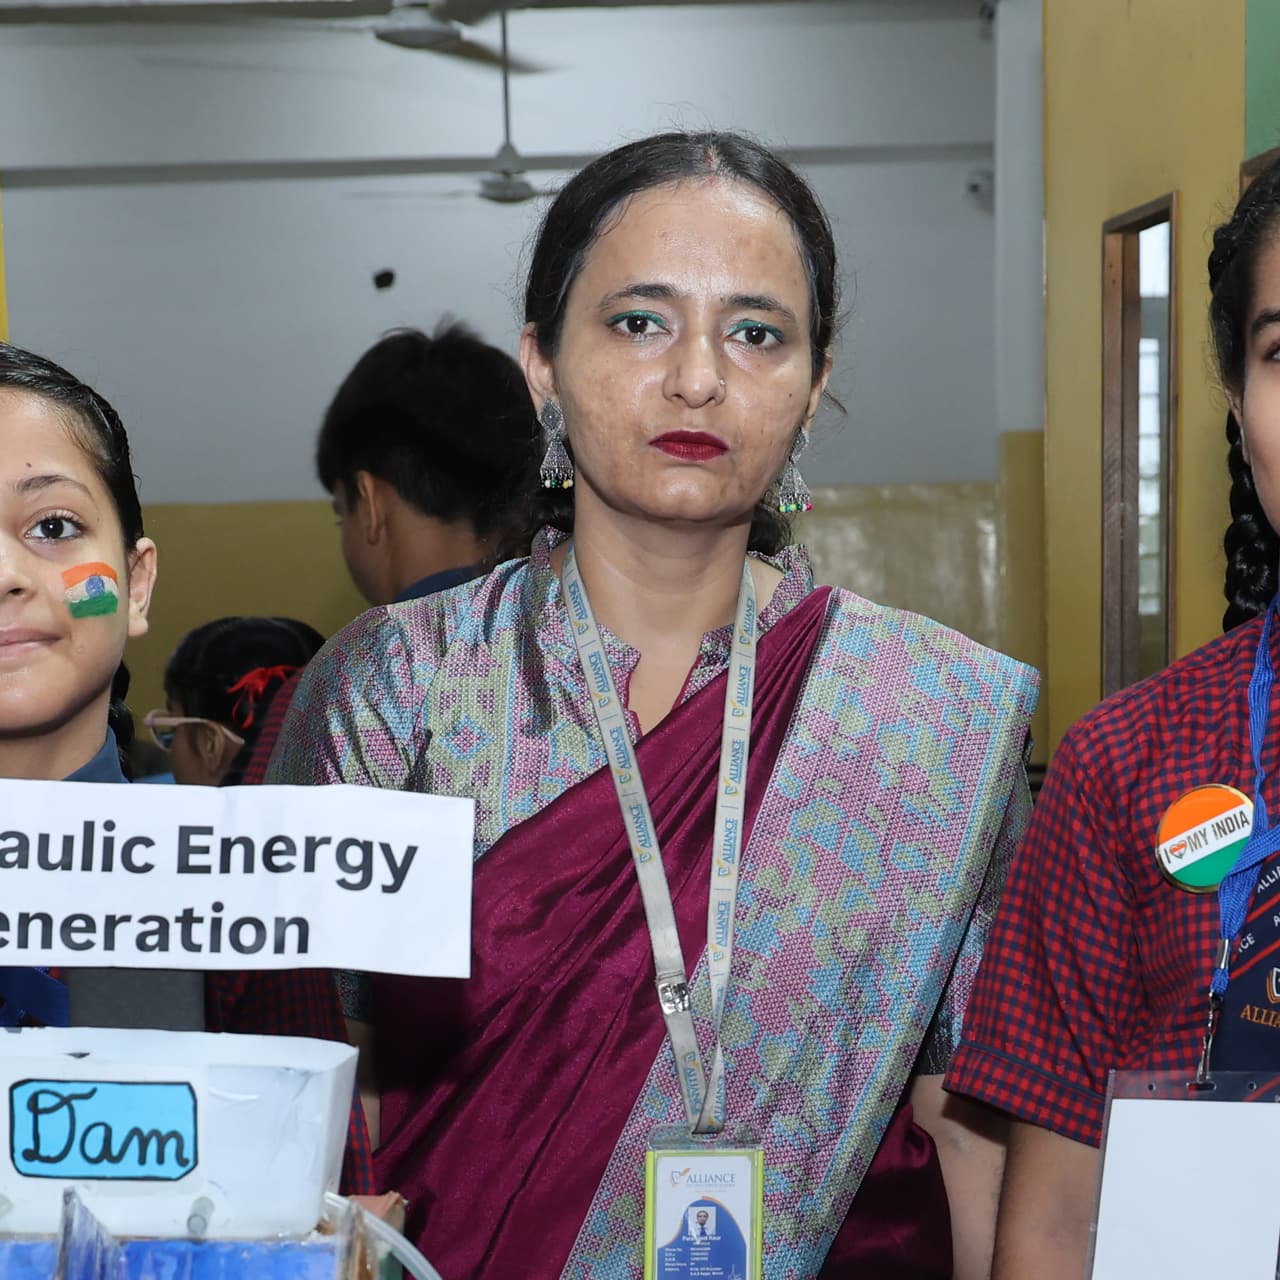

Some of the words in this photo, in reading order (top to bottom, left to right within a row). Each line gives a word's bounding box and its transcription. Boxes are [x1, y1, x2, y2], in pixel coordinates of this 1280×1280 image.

[729, 738, 742, 783] ALLIANCE
[175, 825, 419, 895] Energy
[722, 817, 735, 862] ALLIANCE
[1163, 847, 1172, 865] I
[1186, 828, 1209, 853] MY
[1211, 810, 1250, 841] INDIA
[22, 1086, 191, 1169] Dam
[686, 1172, 736, 1184] ALLIANCE
